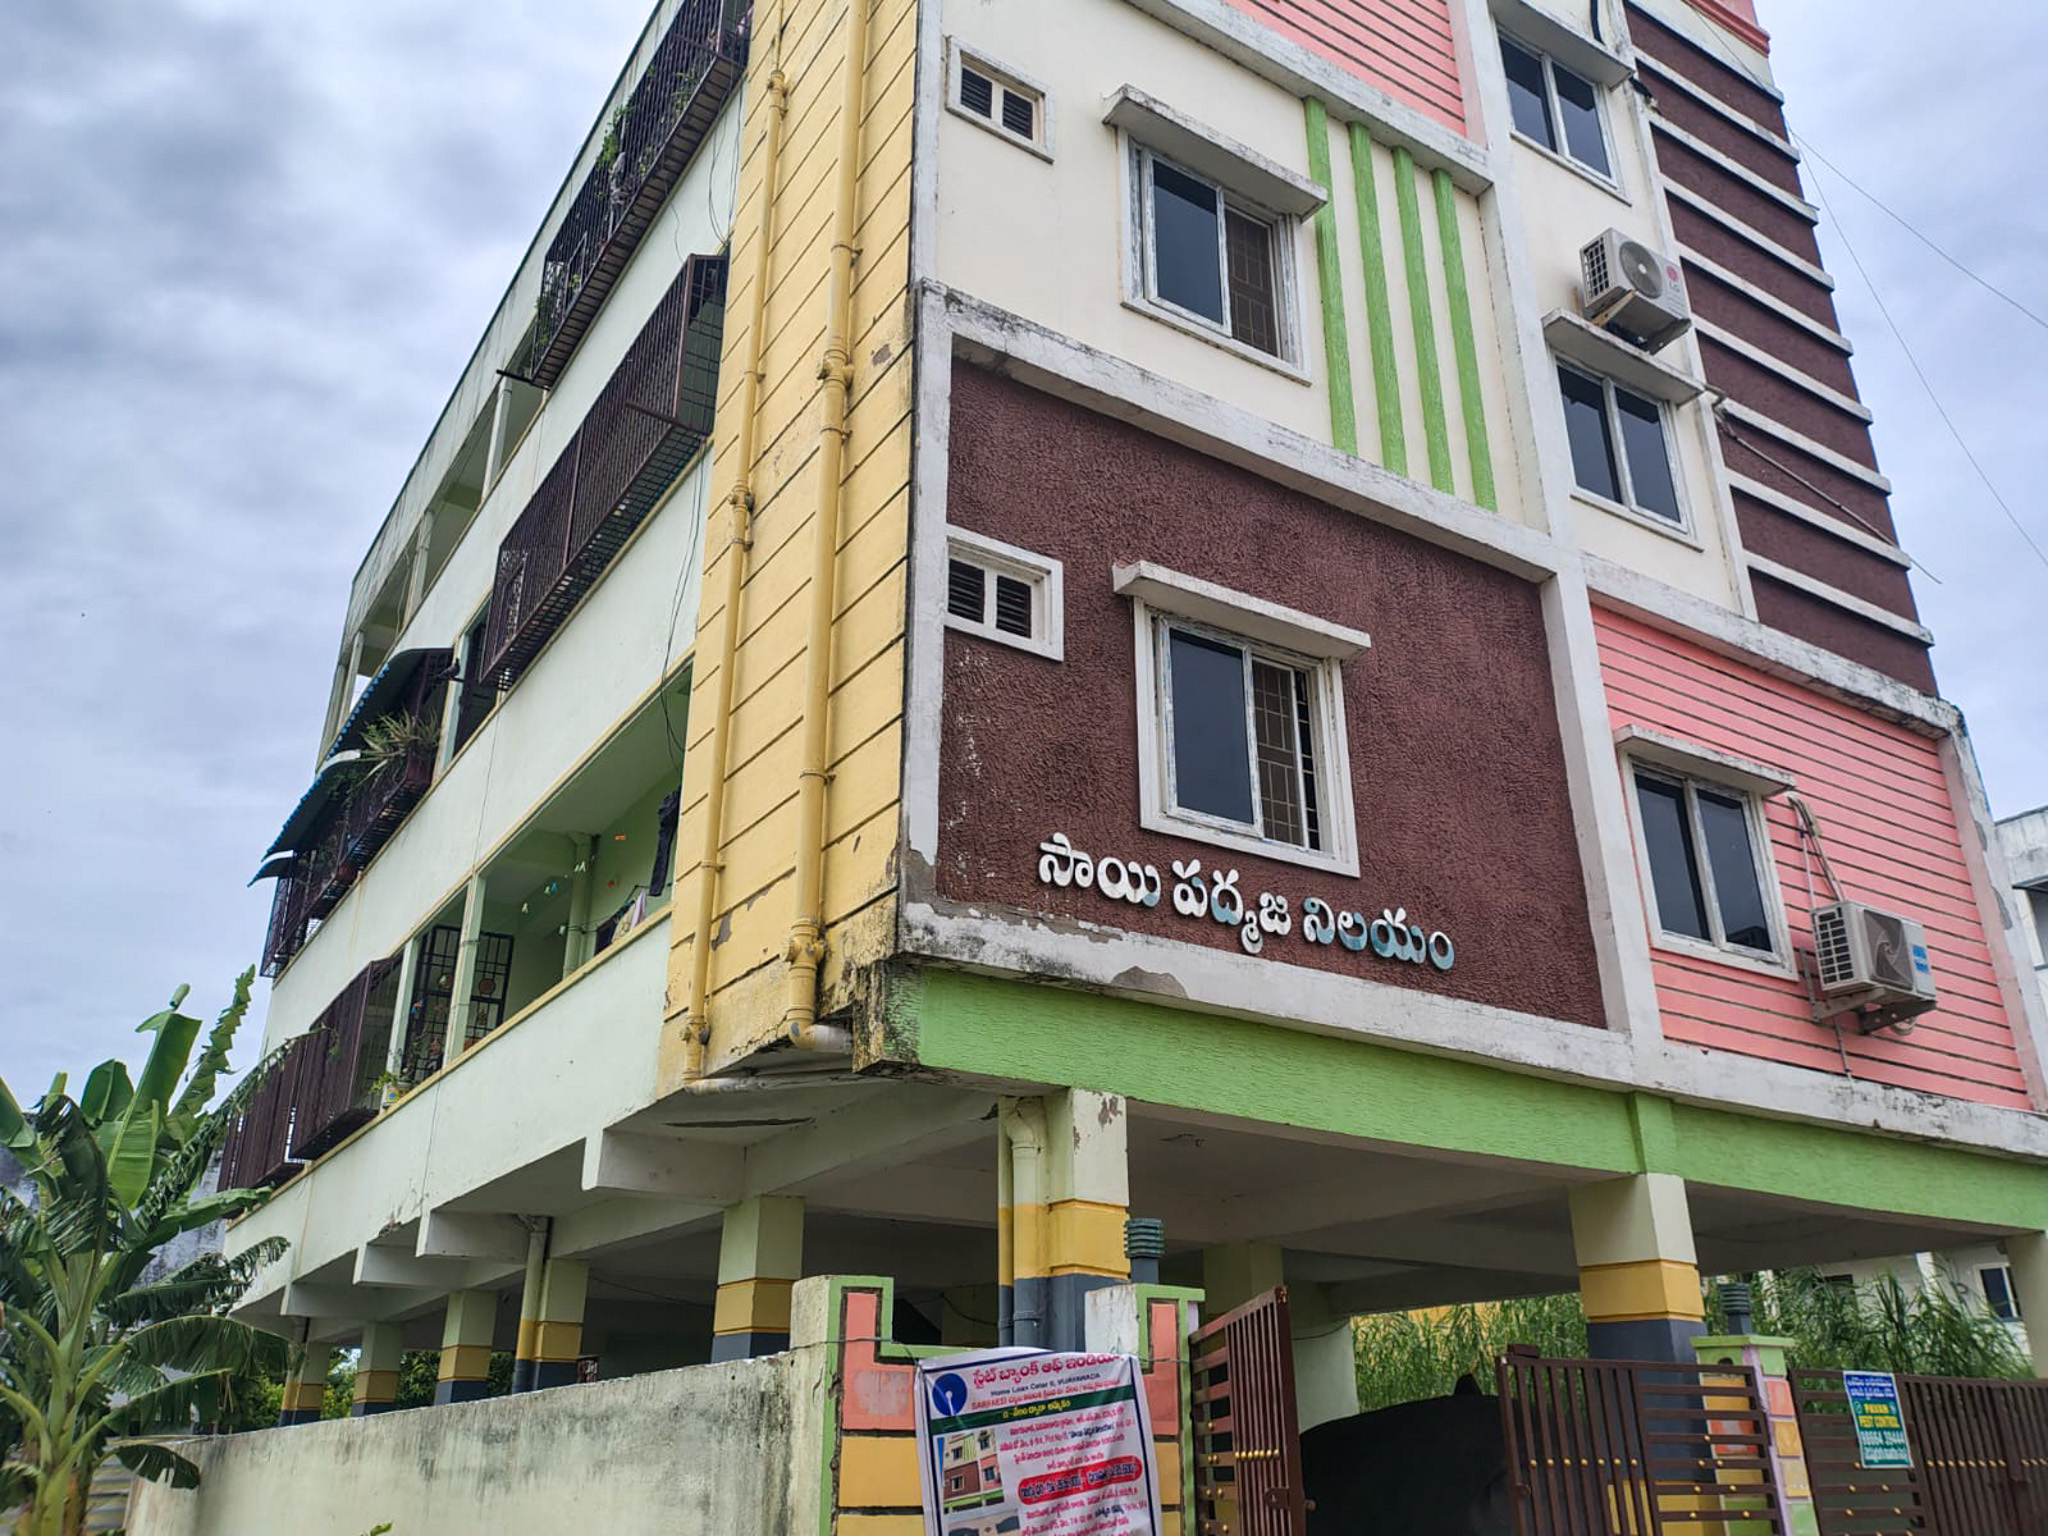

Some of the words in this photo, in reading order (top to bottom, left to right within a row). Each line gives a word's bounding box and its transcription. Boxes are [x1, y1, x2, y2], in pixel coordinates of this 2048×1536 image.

[1039, 832, 1161, 907] సాయి
[1172, 859, 1291, 954] పద్మజ
[1303, 897, 1455, 970] నిలయం
